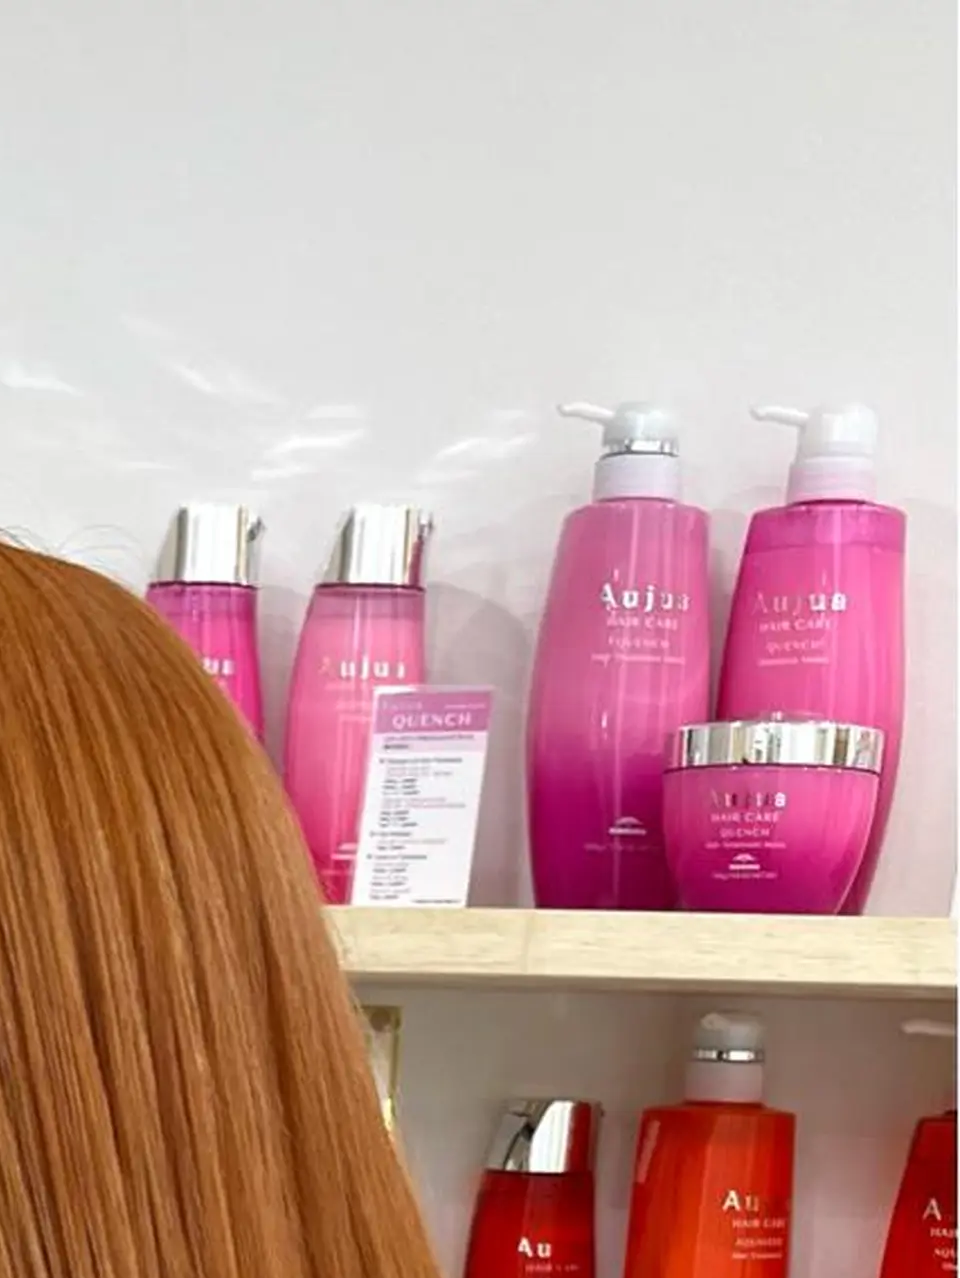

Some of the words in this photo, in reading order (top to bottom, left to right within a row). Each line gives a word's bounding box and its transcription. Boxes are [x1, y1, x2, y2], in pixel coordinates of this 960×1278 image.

[392, 711, 472, 730] QUENCH
[711, 812, 741, 823] HAIR
[745, 811, 780, 823] CARE
